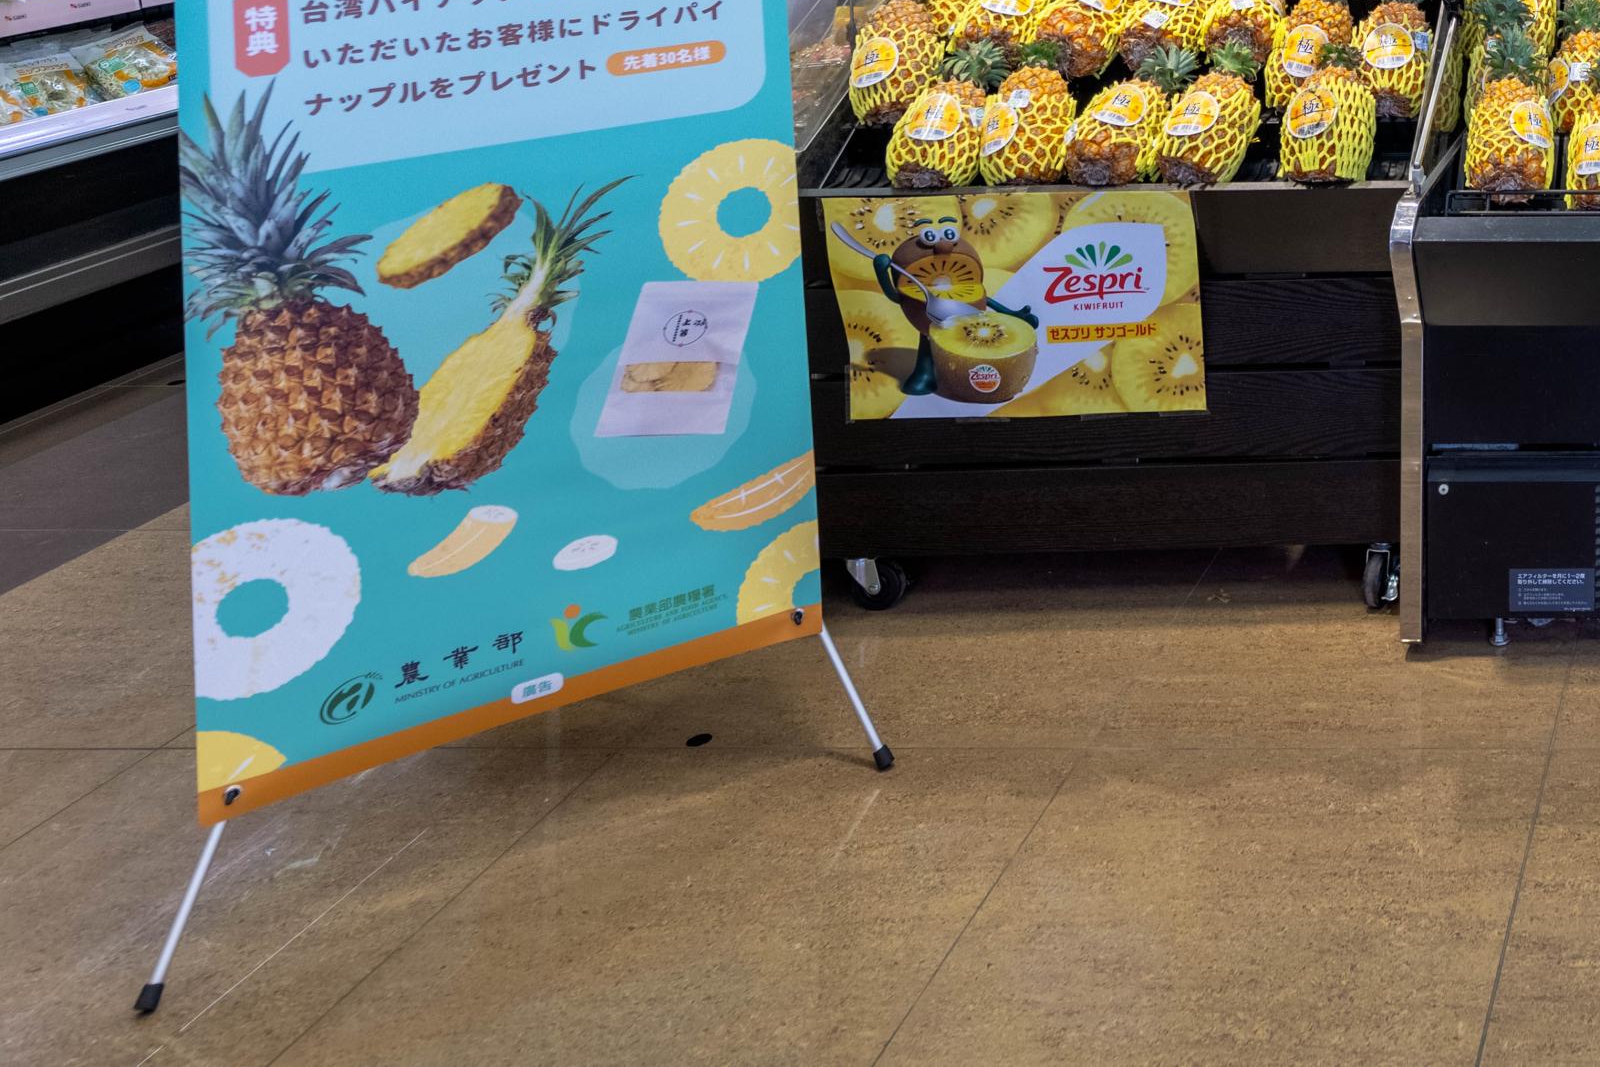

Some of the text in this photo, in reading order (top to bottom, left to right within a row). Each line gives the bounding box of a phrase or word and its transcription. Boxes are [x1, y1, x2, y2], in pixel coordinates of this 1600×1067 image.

[244, 5, 279, 58] 特典
[302, 0, 723, 68] いただいたお客様にドライパイ
[622, 45, 711, 72] 先着30名様
[304, 59, 597, 117] ナップルをプレゼント
[1043, 266, 1144, 304] Zespri
[1073, 301, 1124, 311] KIWIFRUIT
[1094, 323, 1157, 338] サンゴールド
[970, 370, 998, 380] Zespri
[395, 632, 524, 687] 農業部
[394, 658, 525, 704] MINISTRY OF AGRICULTURE
[522, 680, 552, 699] 廣告
